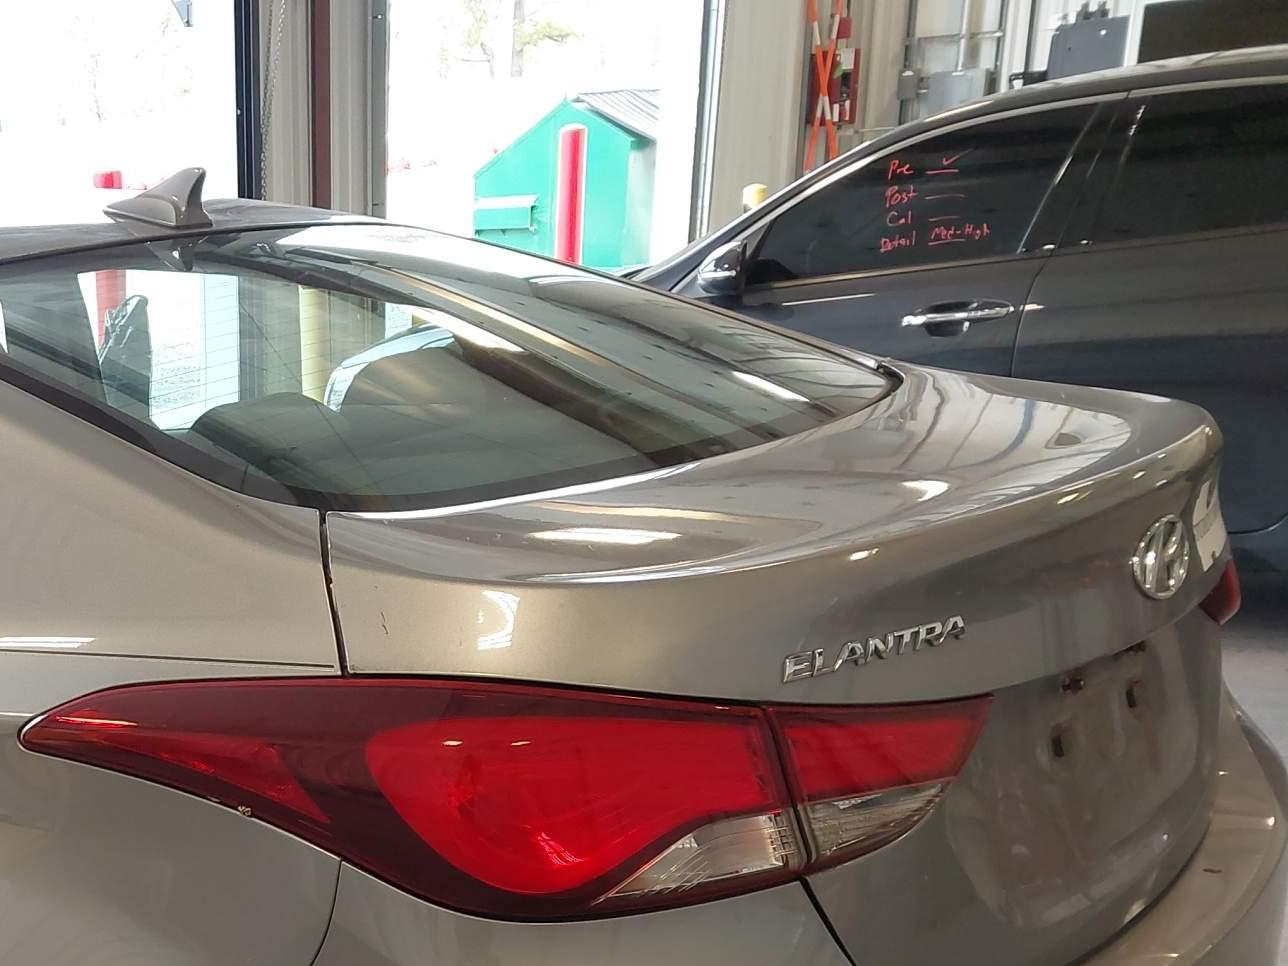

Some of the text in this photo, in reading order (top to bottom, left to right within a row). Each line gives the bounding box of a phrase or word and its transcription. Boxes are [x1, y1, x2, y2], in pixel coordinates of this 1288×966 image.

[888, 159, 914, 180] Pre
[885, 184, 918, 208] Post
[782, 615, 966, 684] ELANTRA
